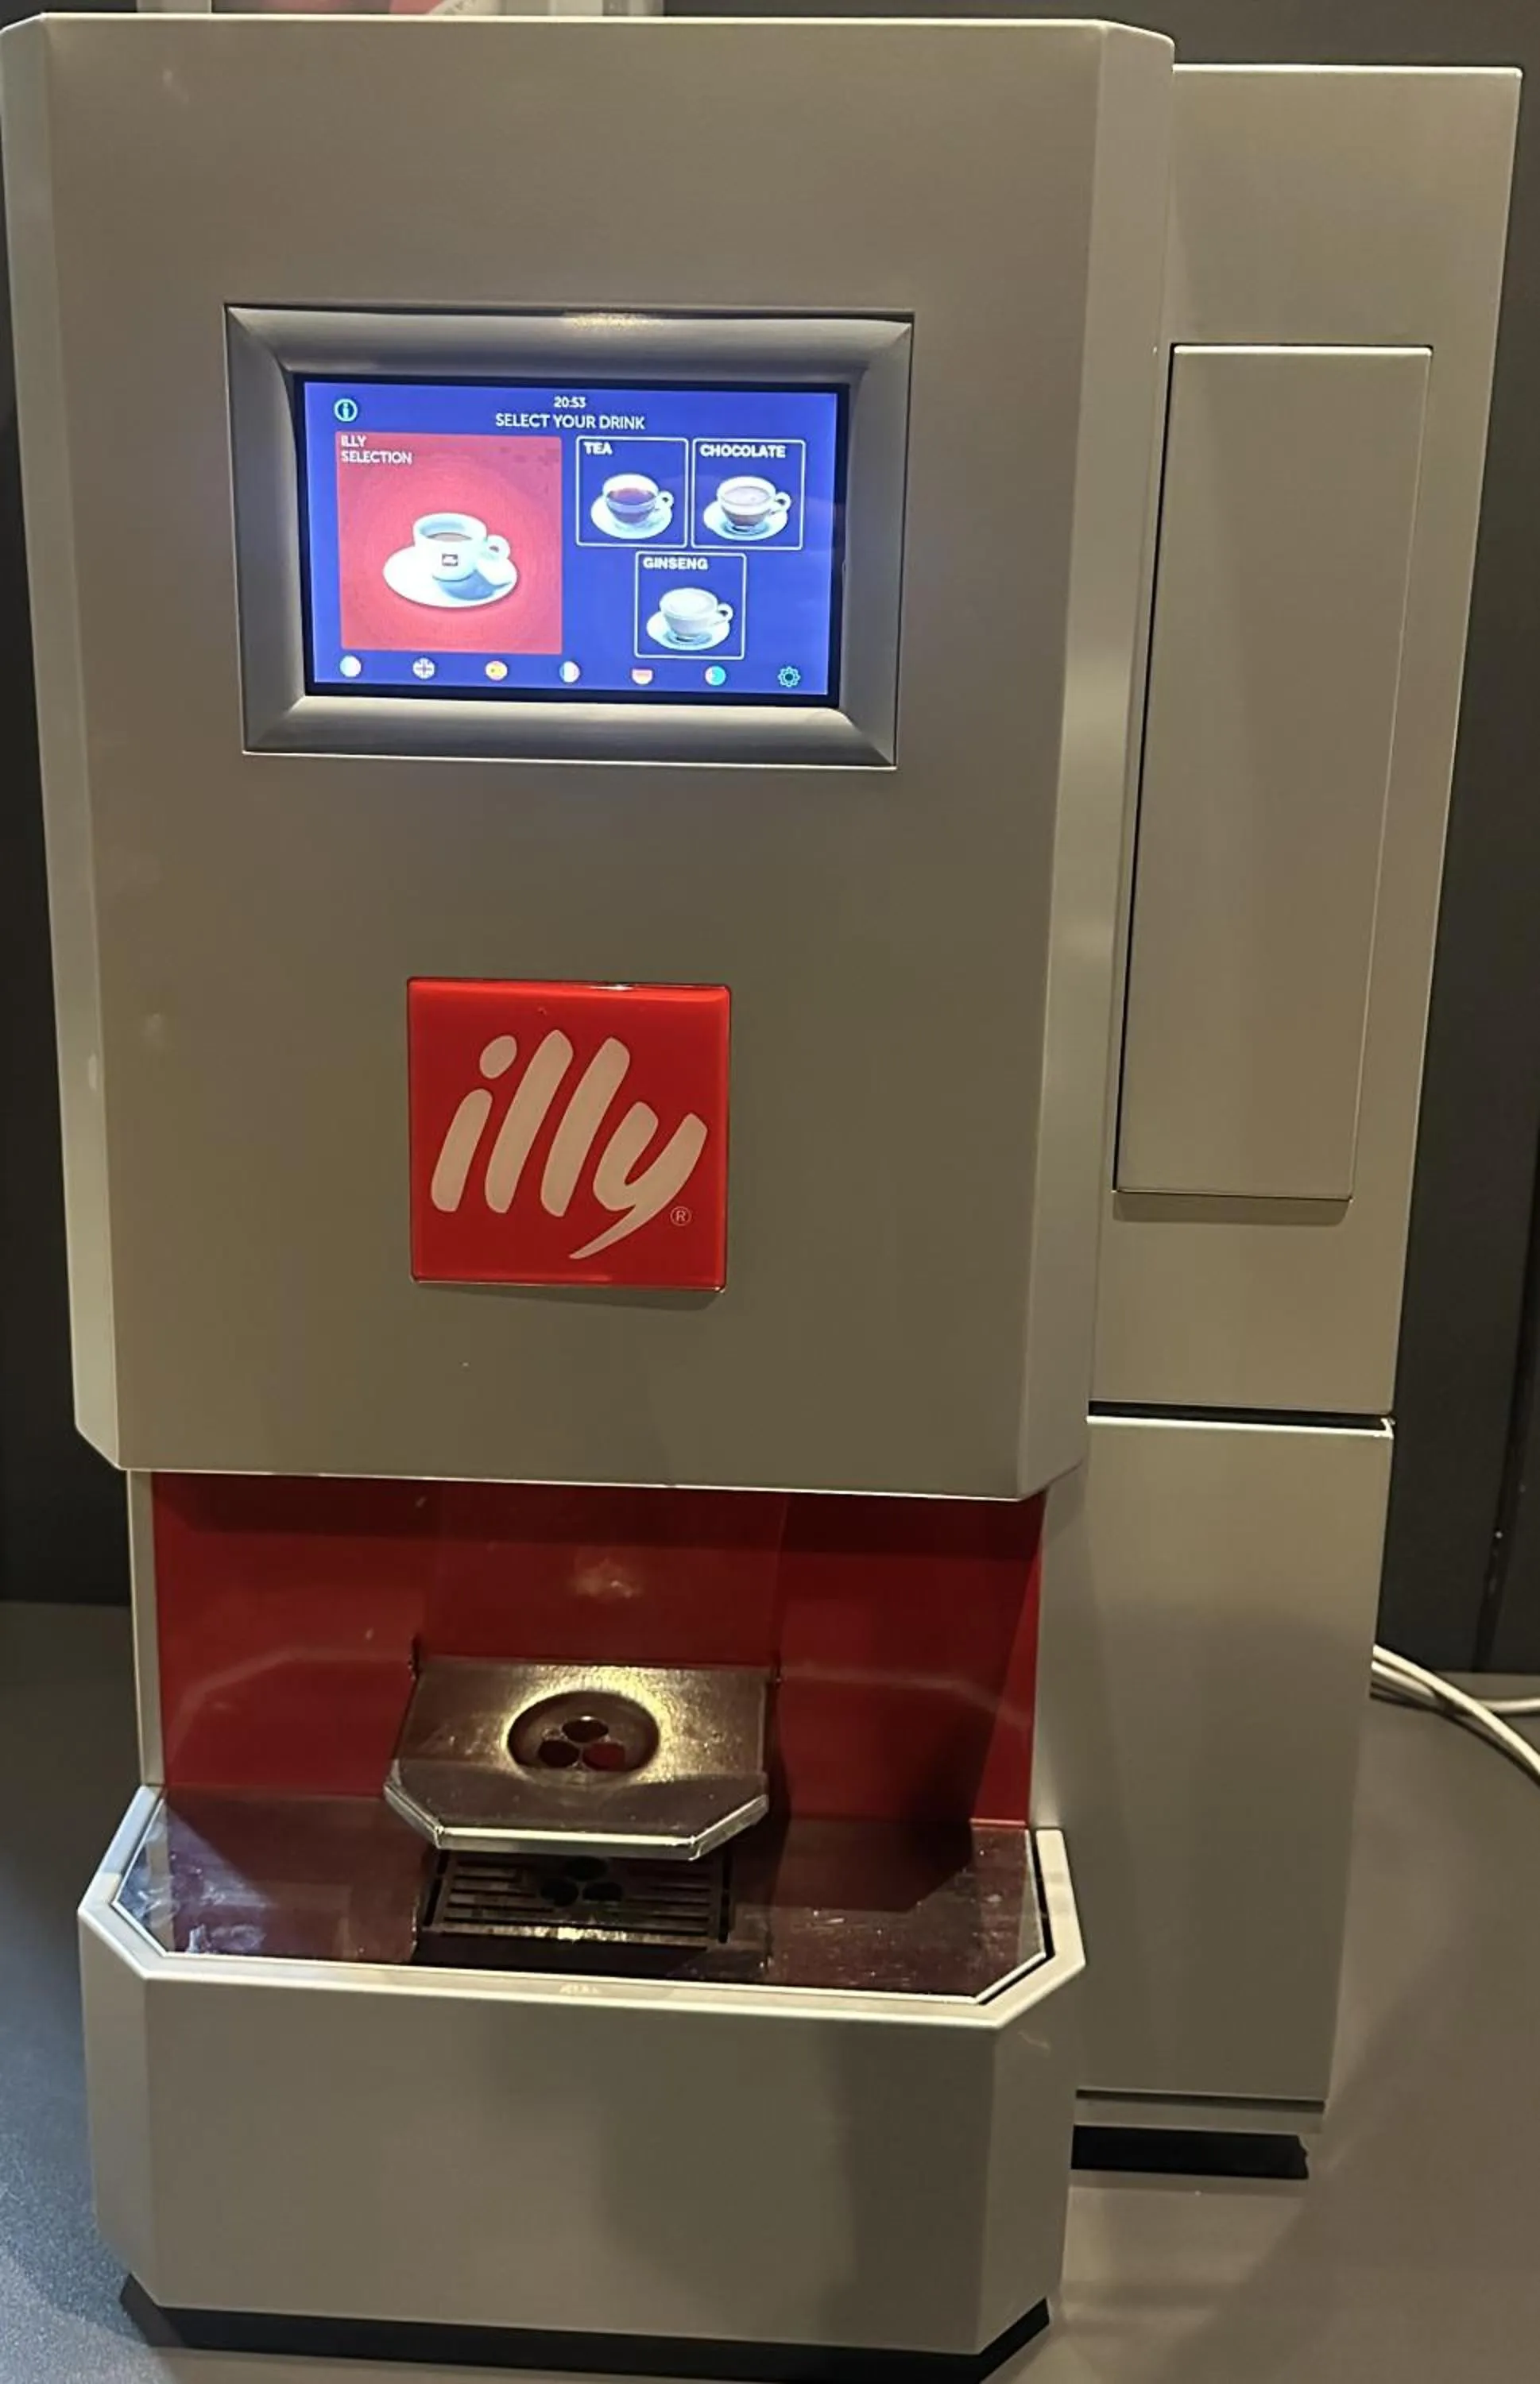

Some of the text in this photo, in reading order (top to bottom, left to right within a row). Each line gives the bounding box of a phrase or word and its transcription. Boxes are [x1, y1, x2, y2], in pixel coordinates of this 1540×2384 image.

[554, 397, 586, 408] 20:53
[496, 413, 645, 430] SELECT YOUR DRINK
[341, 435, 367, 447] ILLY
[583, 442, 613, 455] TEA
[700, 444, 786, 459] CHOCOLATE
[341, 451, 413, 465] SELECTION
[643, 558, 708, 571] GINSENG
[431, 1029, 708, 1260] illy
